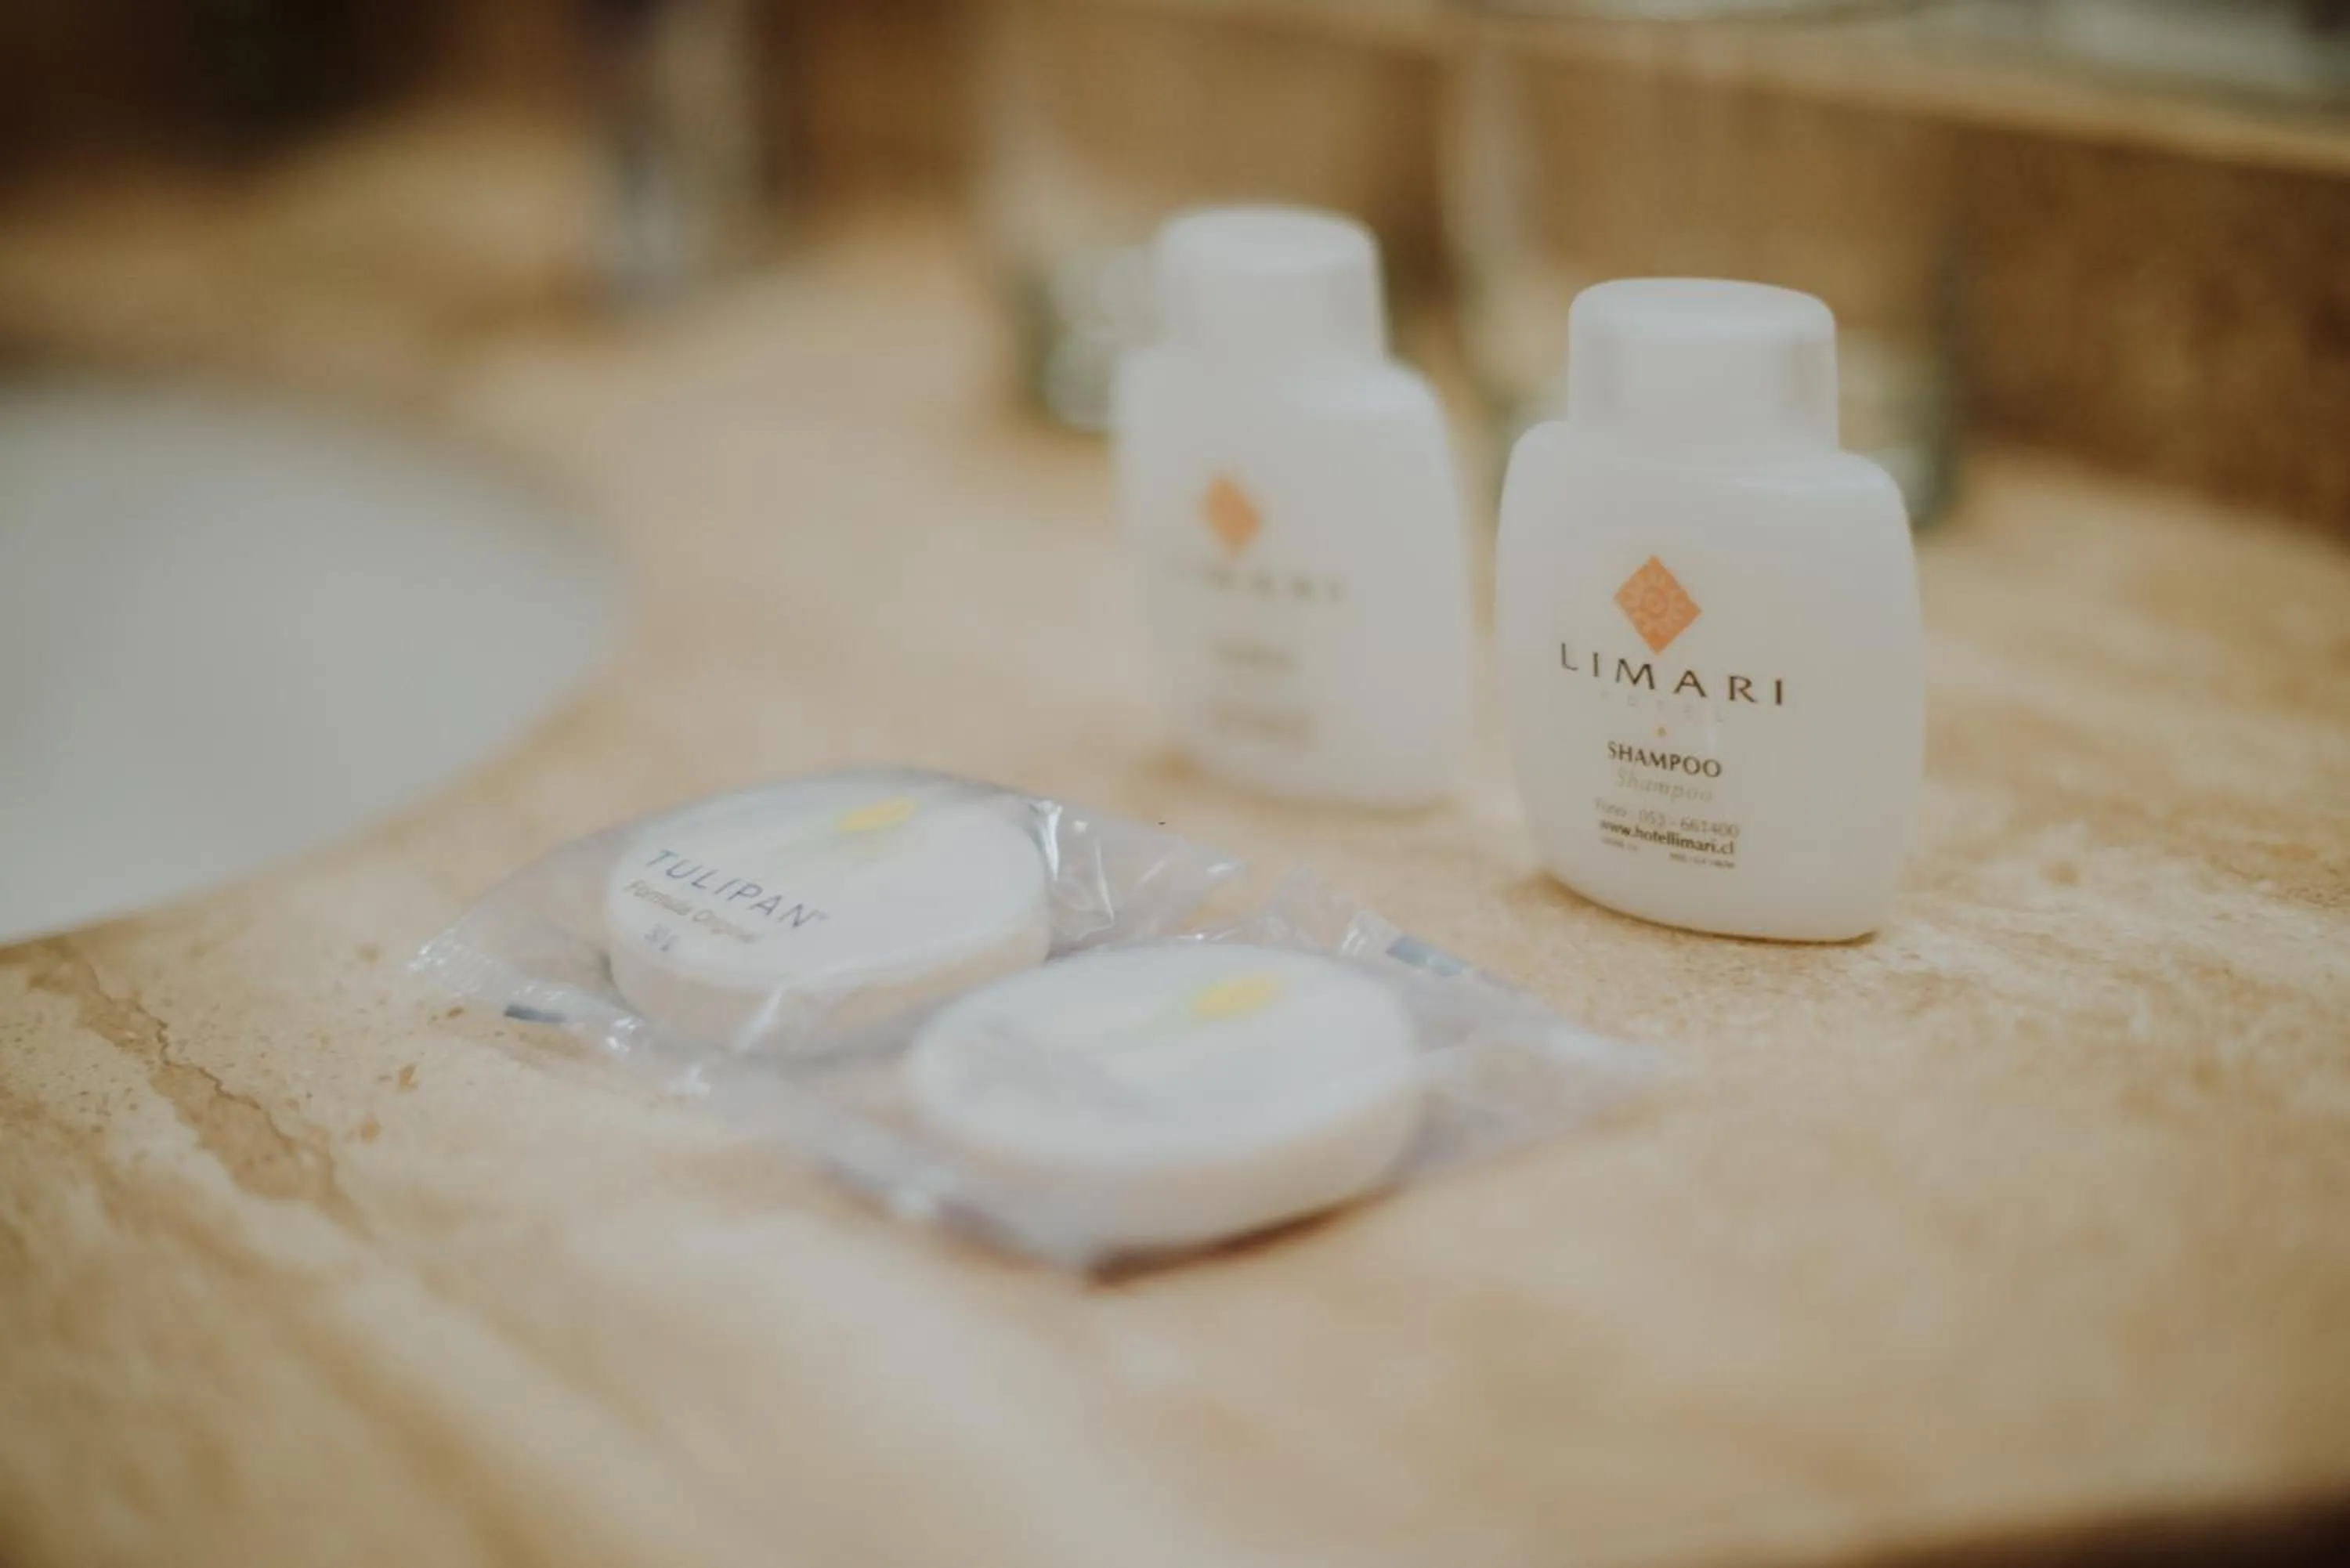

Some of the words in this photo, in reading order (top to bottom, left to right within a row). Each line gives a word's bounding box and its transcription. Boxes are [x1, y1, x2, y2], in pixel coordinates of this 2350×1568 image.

[1560, 642, 1784, 706] LIMARI
[1607, 740, 1722, 778] SHAMPOO
[1614, 768, 1714, 803] Shampoo
